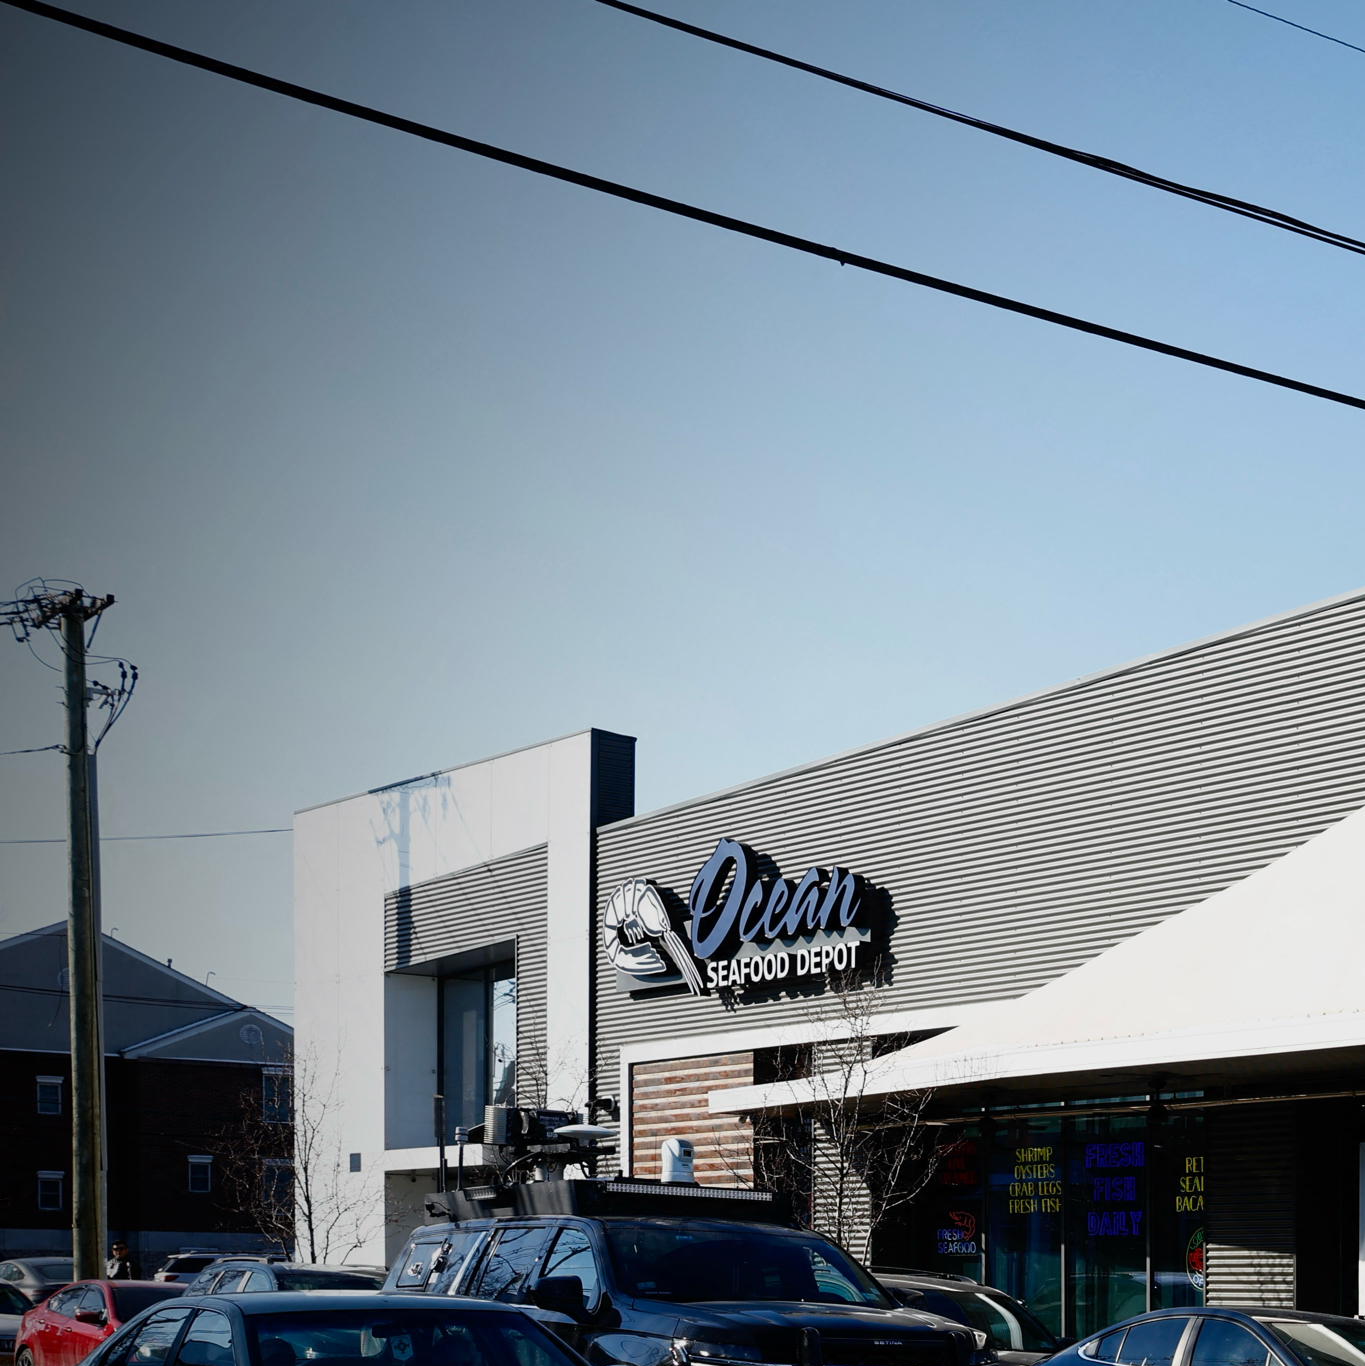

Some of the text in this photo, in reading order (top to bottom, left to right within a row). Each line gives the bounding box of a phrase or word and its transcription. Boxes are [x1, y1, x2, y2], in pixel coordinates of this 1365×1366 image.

[690, 838, 862, 959] Ocean
[707, 941, 860, 989] SEAFOOD DEPOT
[1015, 1146, 1053, 1163] SHRIMP
[1085, 1141, 1145, 1168] FRESH
[1014, 1163, 1056, 1180] OYSTERS
[1009, 1180, 1062, 1197] CRAB LEGS
[1093, 1176, 1136, 1202] FISH
[1009, 1199, 1038, 1214] FRESH
[1087, 1211, 1143, 1236] DAILY
[937, 1229, 963, 1240] FRESH
[937, 1241, 977, 1254] SEAFOOD
